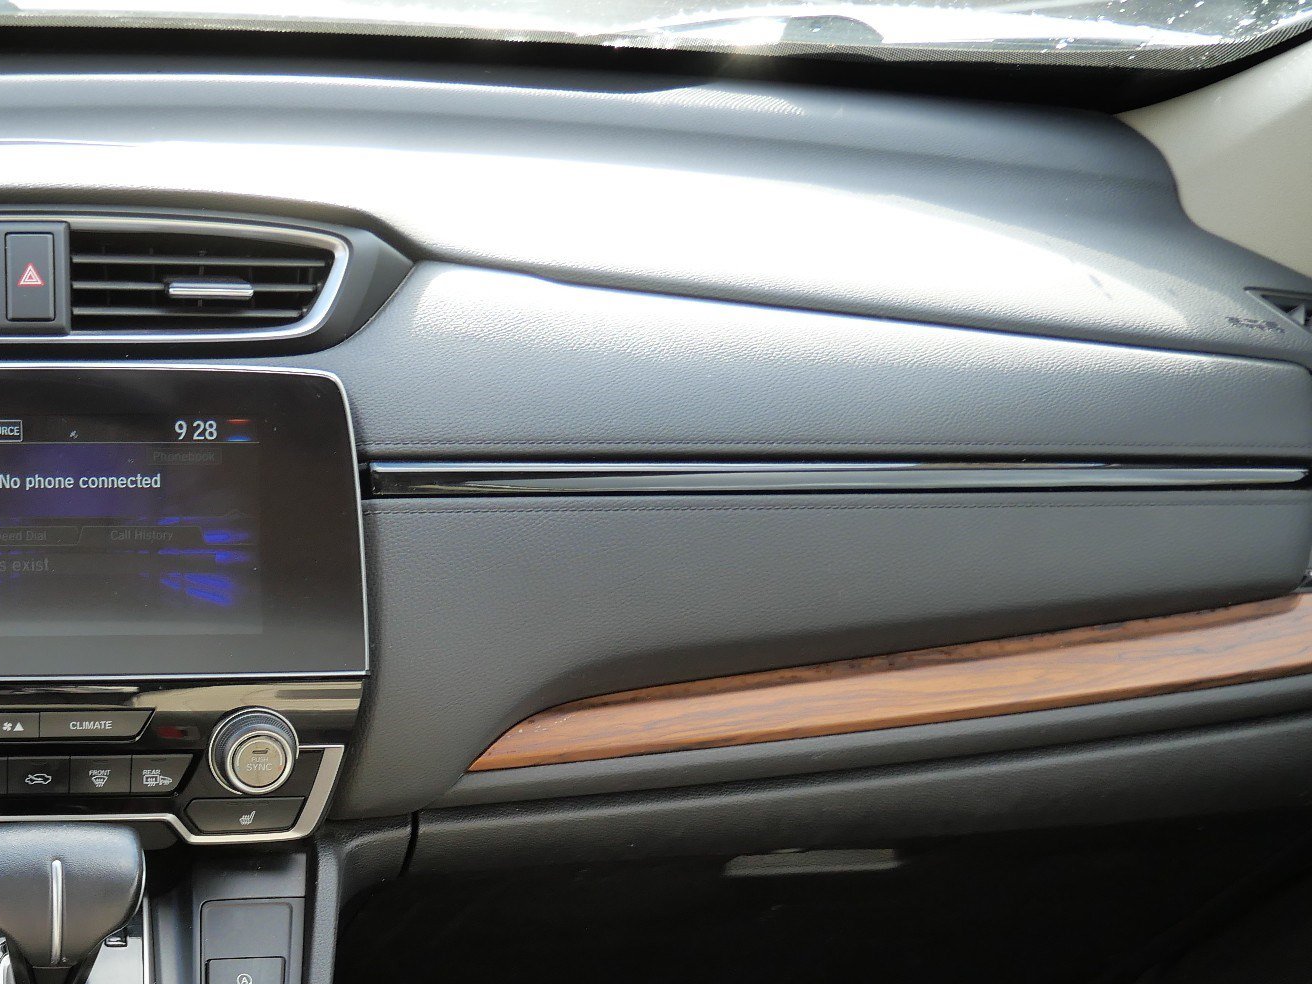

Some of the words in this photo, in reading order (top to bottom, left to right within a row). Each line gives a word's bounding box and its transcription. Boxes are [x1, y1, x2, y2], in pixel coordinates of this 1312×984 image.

[25, 474, 75, 491] phone
[79, 473, 161, 489] connected
[110, 530, 131, 541] Call
[136, 530, 173, 542] History
[12, 558, 49, 572] exist
[69, 720, 113, 730] CLIMATE
[246, 763, 273, 772] SYNC
